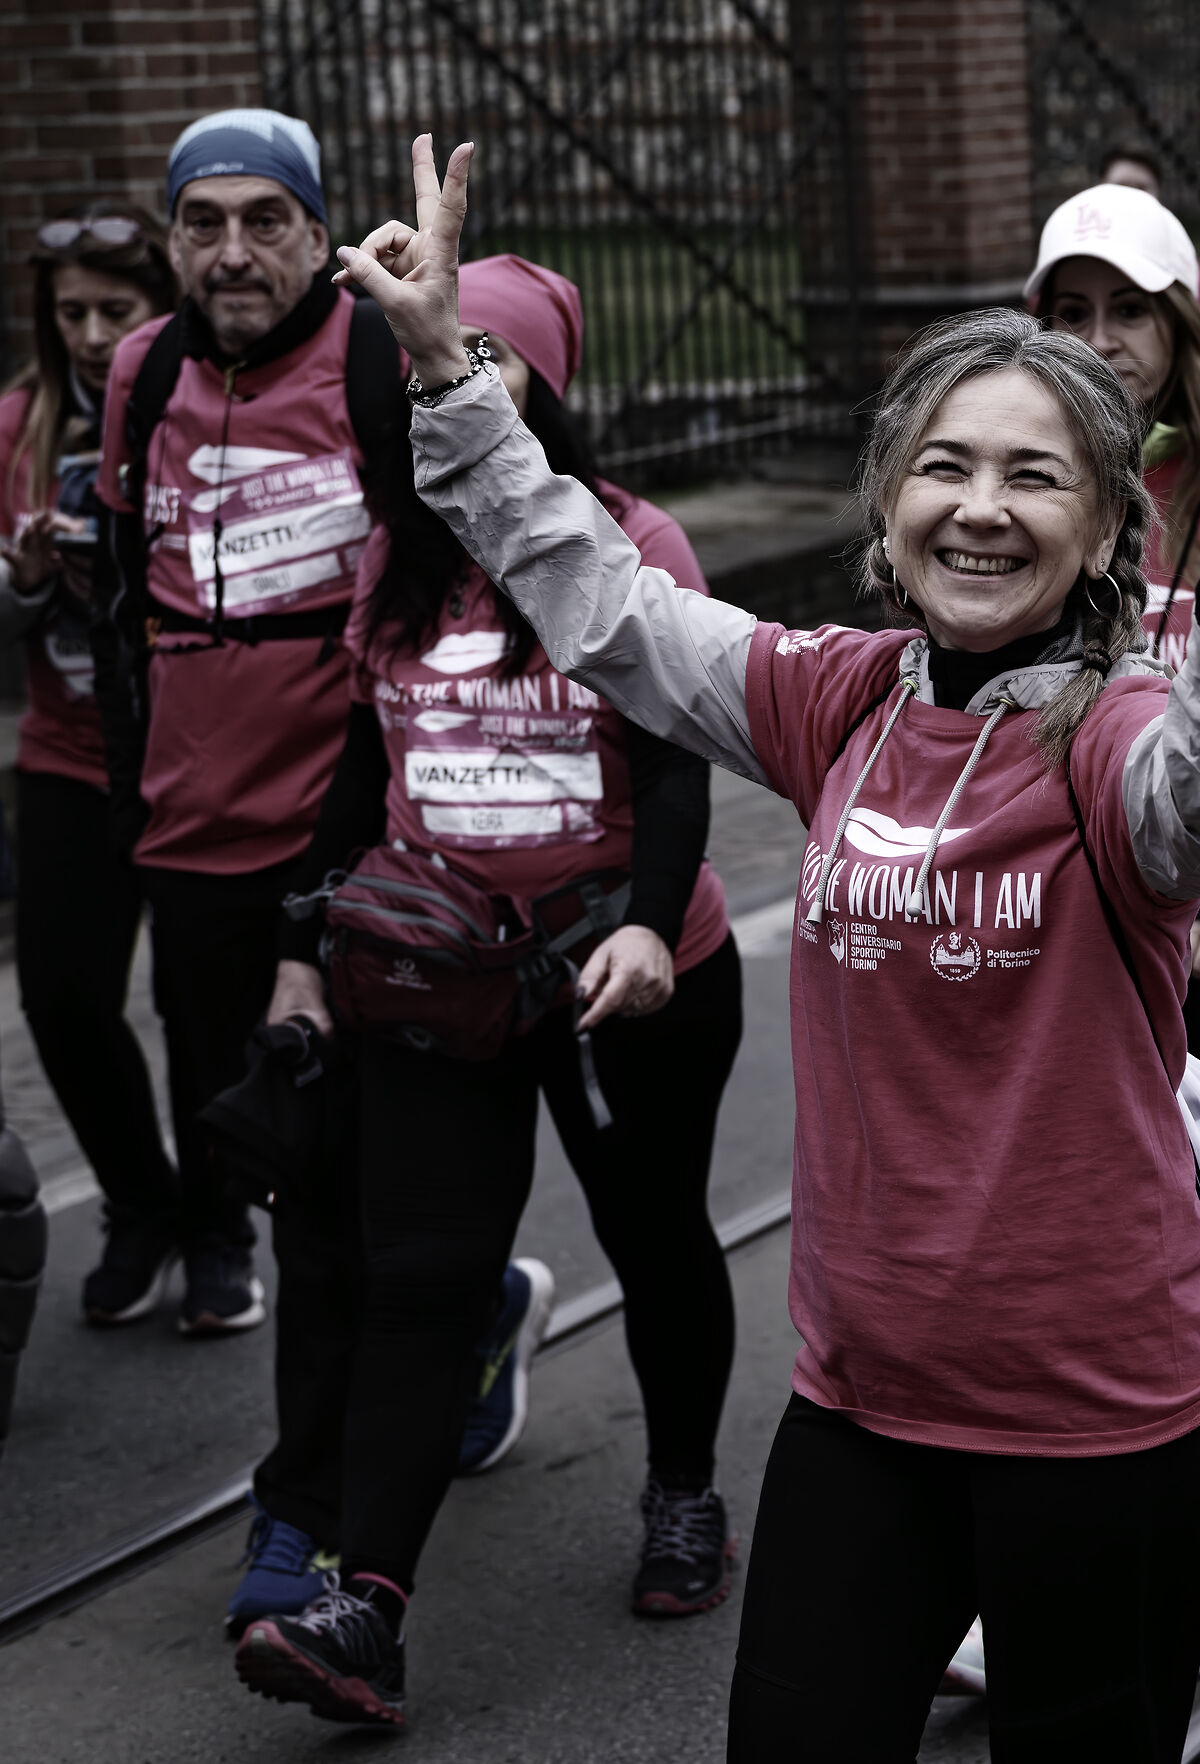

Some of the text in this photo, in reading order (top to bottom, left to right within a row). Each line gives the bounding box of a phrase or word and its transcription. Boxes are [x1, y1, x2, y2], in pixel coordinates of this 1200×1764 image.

[457, 676, 543, 712] WOMAN
[549, 672, 560, 712] I
[414, 766, 523, 786] VANZETTI
[848, 861, 958, 926] WOMAN
[973, 871, 984, 928] I
[994, 872, 1042, 929] AM
[850, 923, 878, 936] CENTRO
[850, 934, 902, 951] UNIVERSITARIO
[850, 946, 886, 960] SPORTIVO
[986, 947, 1040, 959] Politecnico
[850, 958, 878, 971] TORINO
[986, 958, 1031, 969] di Torino
